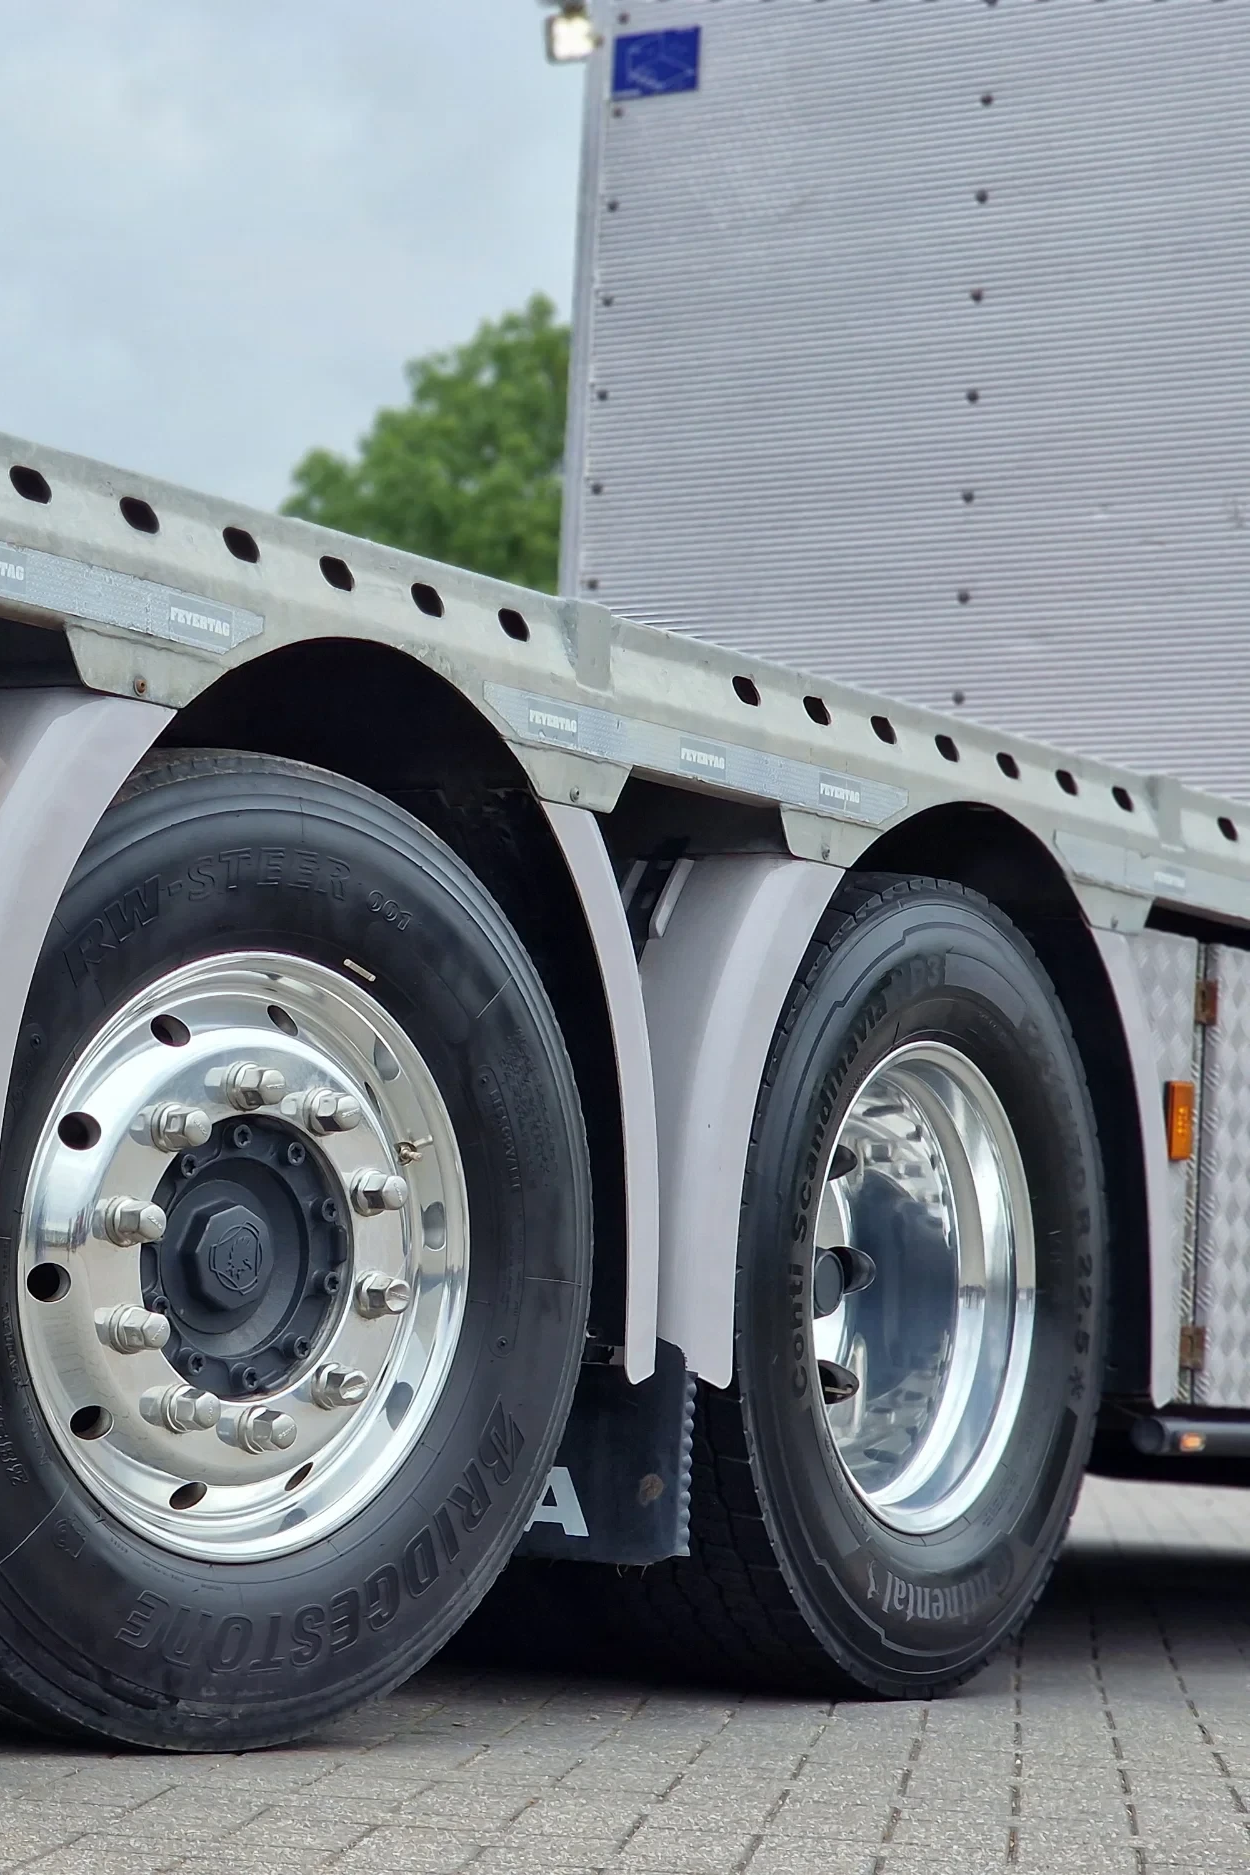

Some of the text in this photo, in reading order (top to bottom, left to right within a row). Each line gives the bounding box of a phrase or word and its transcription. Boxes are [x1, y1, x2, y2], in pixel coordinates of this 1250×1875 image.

[170, 607, 230, 637] FEYERTAG
[529, 708, 578, 733] FEYERTAG
[681, 748, 725, 770] FEYERTAG
[820, 782, 860, 804] FEYERTAG
[115, 1394, 526, 1673] BRIDGESTONE
